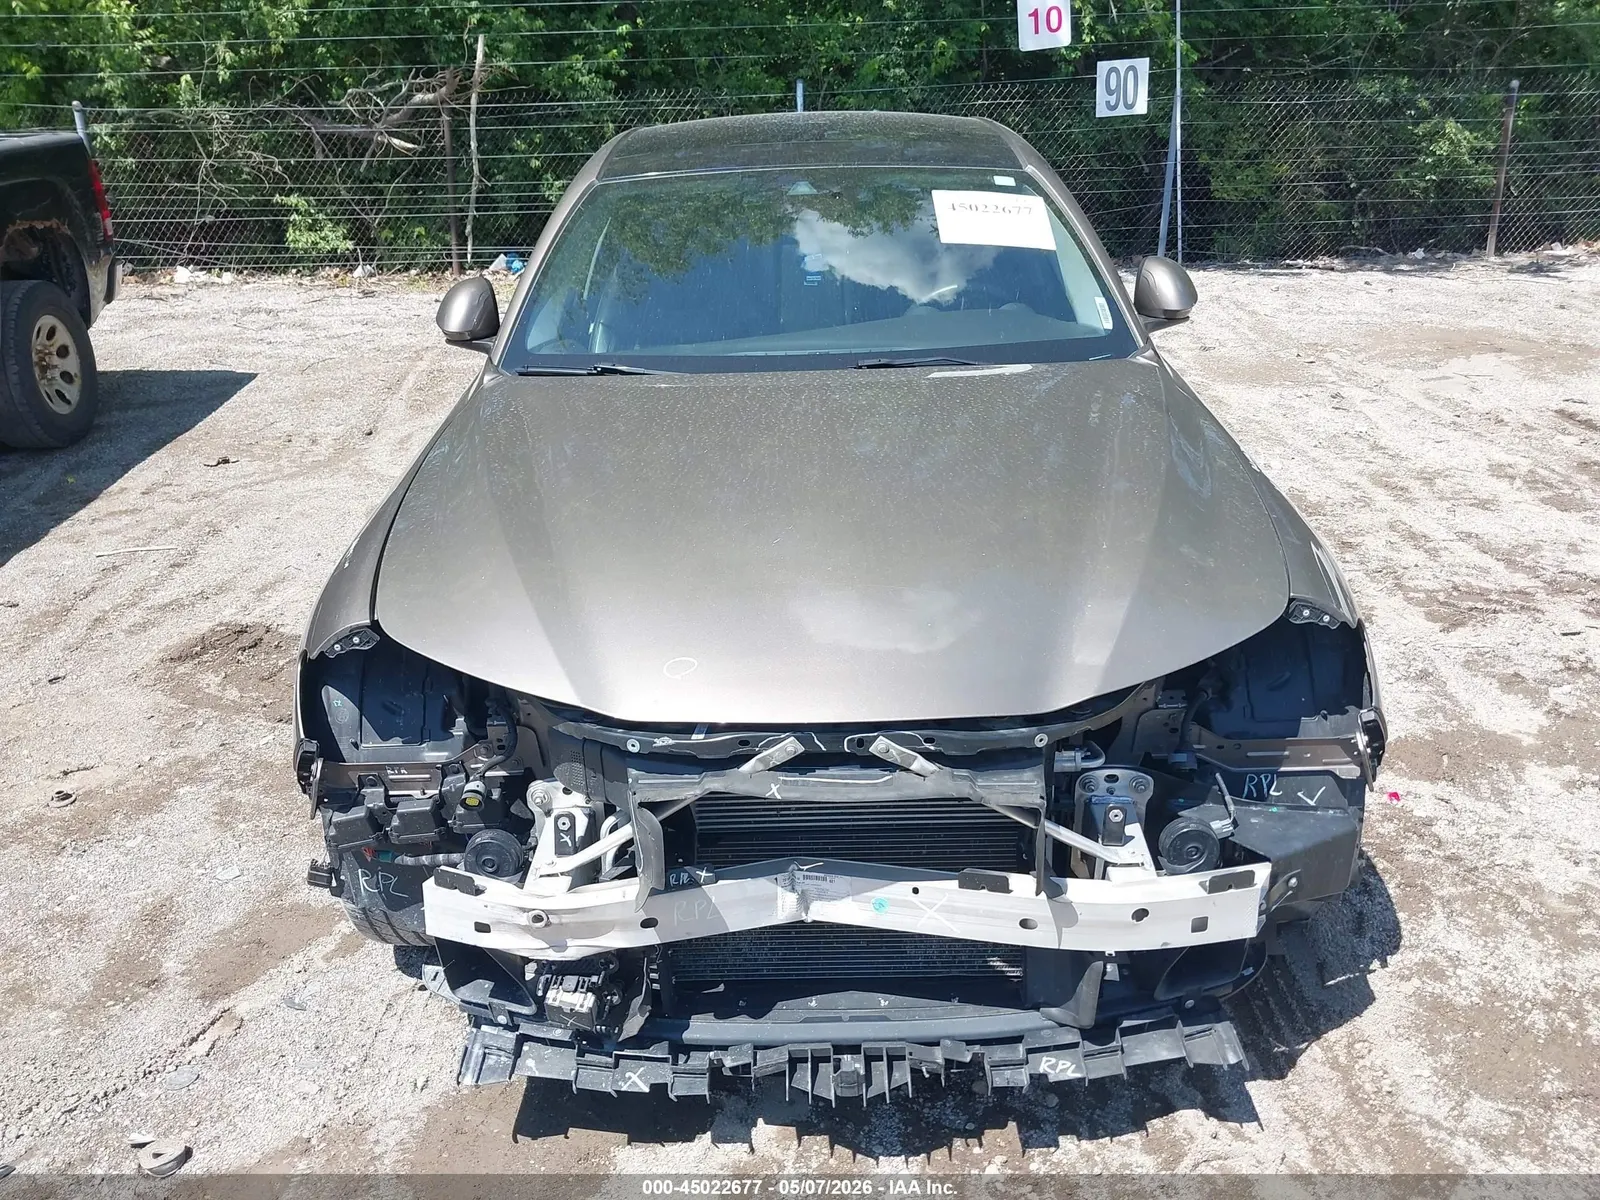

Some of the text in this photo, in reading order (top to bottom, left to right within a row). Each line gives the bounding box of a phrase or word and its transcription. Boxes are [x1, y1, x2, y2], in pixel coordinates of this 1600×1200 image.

[1028, 5, 1062, 35] 10
[1105, 65, 1139, 112] 90
[948, 202, 1032, 215] 45022677
[1242, 773, 1283, 799] RPL
[358, 868, 410, 897] RPL
[1039, 1056, 1082, 1078] RPL
